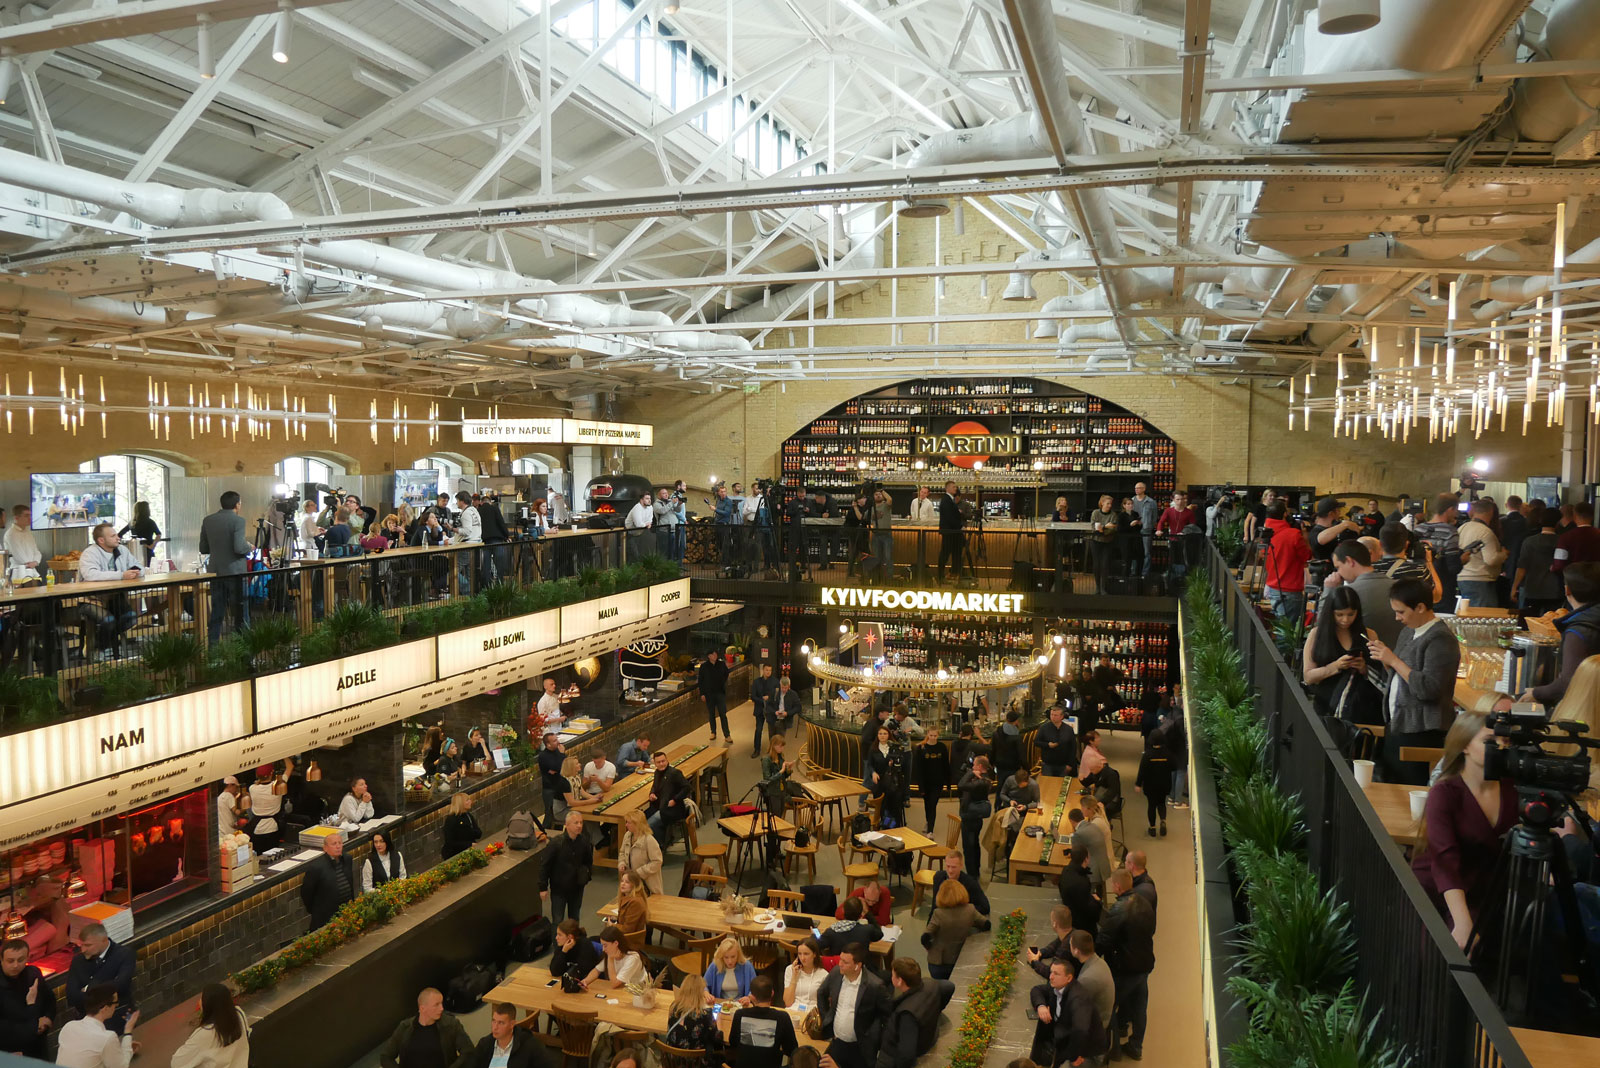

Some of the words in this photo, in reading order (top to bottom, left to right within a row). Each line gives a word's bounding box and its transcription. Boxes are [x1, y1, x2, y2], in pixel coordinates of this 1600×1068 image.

[472, 426, 503, 435] LIBERTY
[506, 426, 516, 435] BY
[518, 426, 552, 435] NAPULE
[578, 427, 598, 437] LIBERTY
[598, 428, 605, 437] BY
[605, 429, 624, 438] PIZZERIA
[624, 430, 641, 439] NAPULE
[917, 435, 1020, 454] MARTINI
[660, 590, 681, 604] COOPER
[821, 586, 1025, 613] KYIVFOODMARKET
[598, 606, 619, 621] MALVA
[483, 636, 501, 652] BALI
[503, 630, 526, 647] BOWL
[336, 668, 377, 692] ADELLE
[100, 727, 145, 755] NAM
